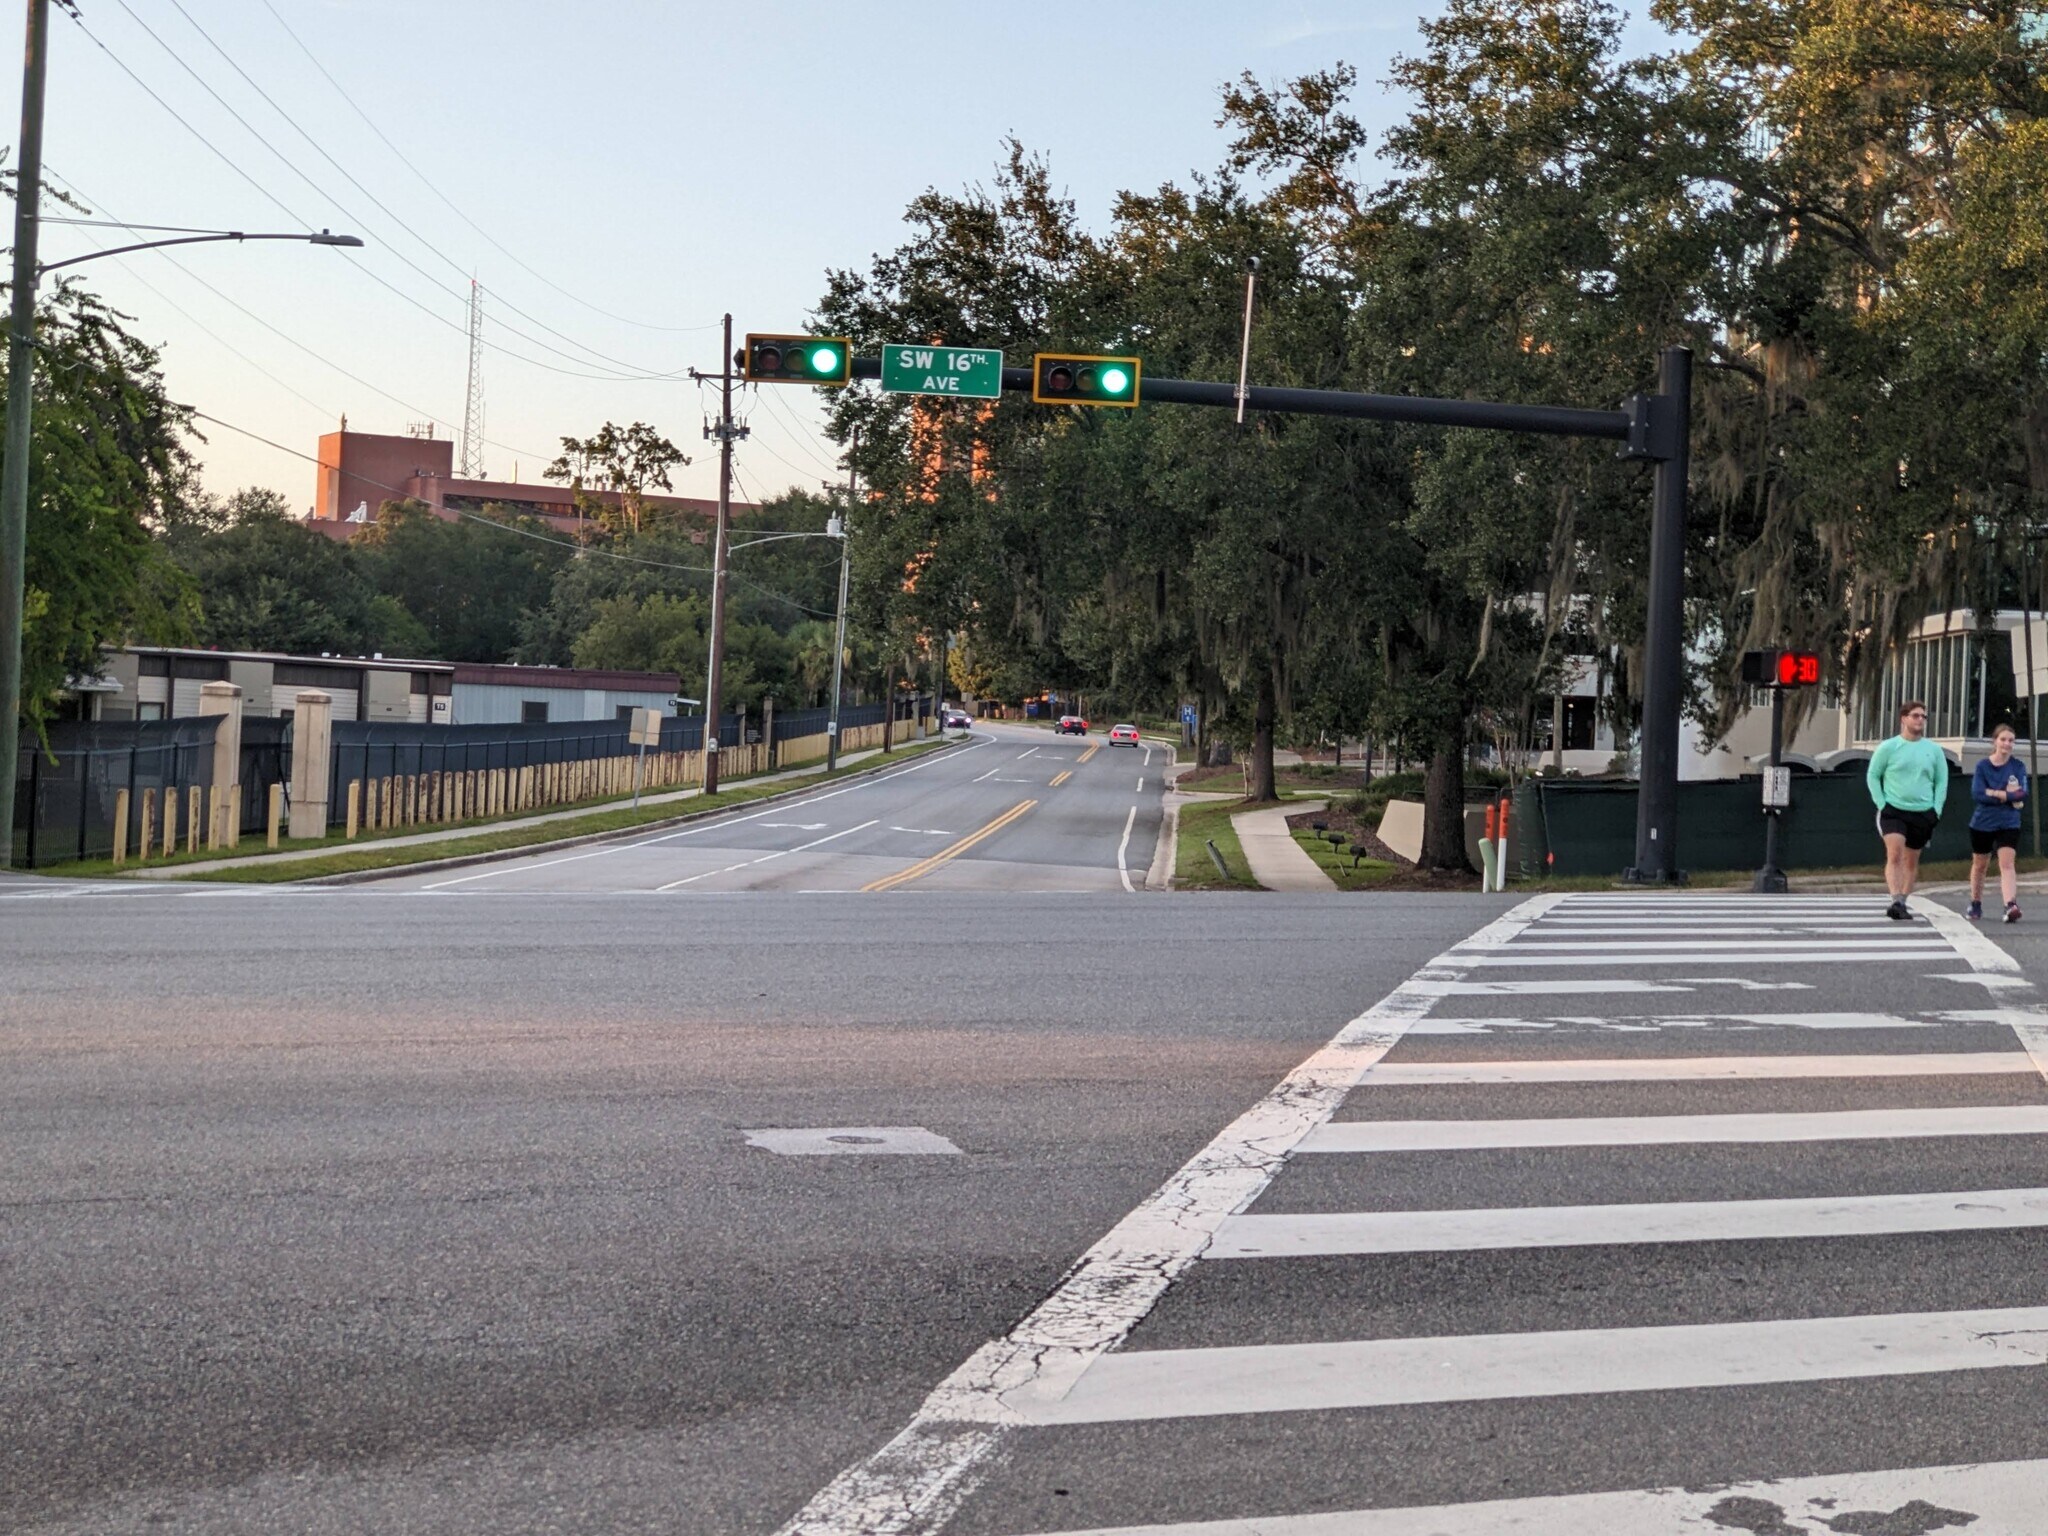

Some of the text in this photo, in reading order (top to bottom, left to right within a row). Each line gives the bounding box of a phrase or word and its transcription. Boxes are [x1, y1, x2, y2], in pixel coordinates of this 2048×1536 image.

[900, 350, 986, 371] SW 16TH
[923, 376, 959, 391] AVE
[1799, 657, 1817, 681] 30
[1184, 708, 1192, 716] H
